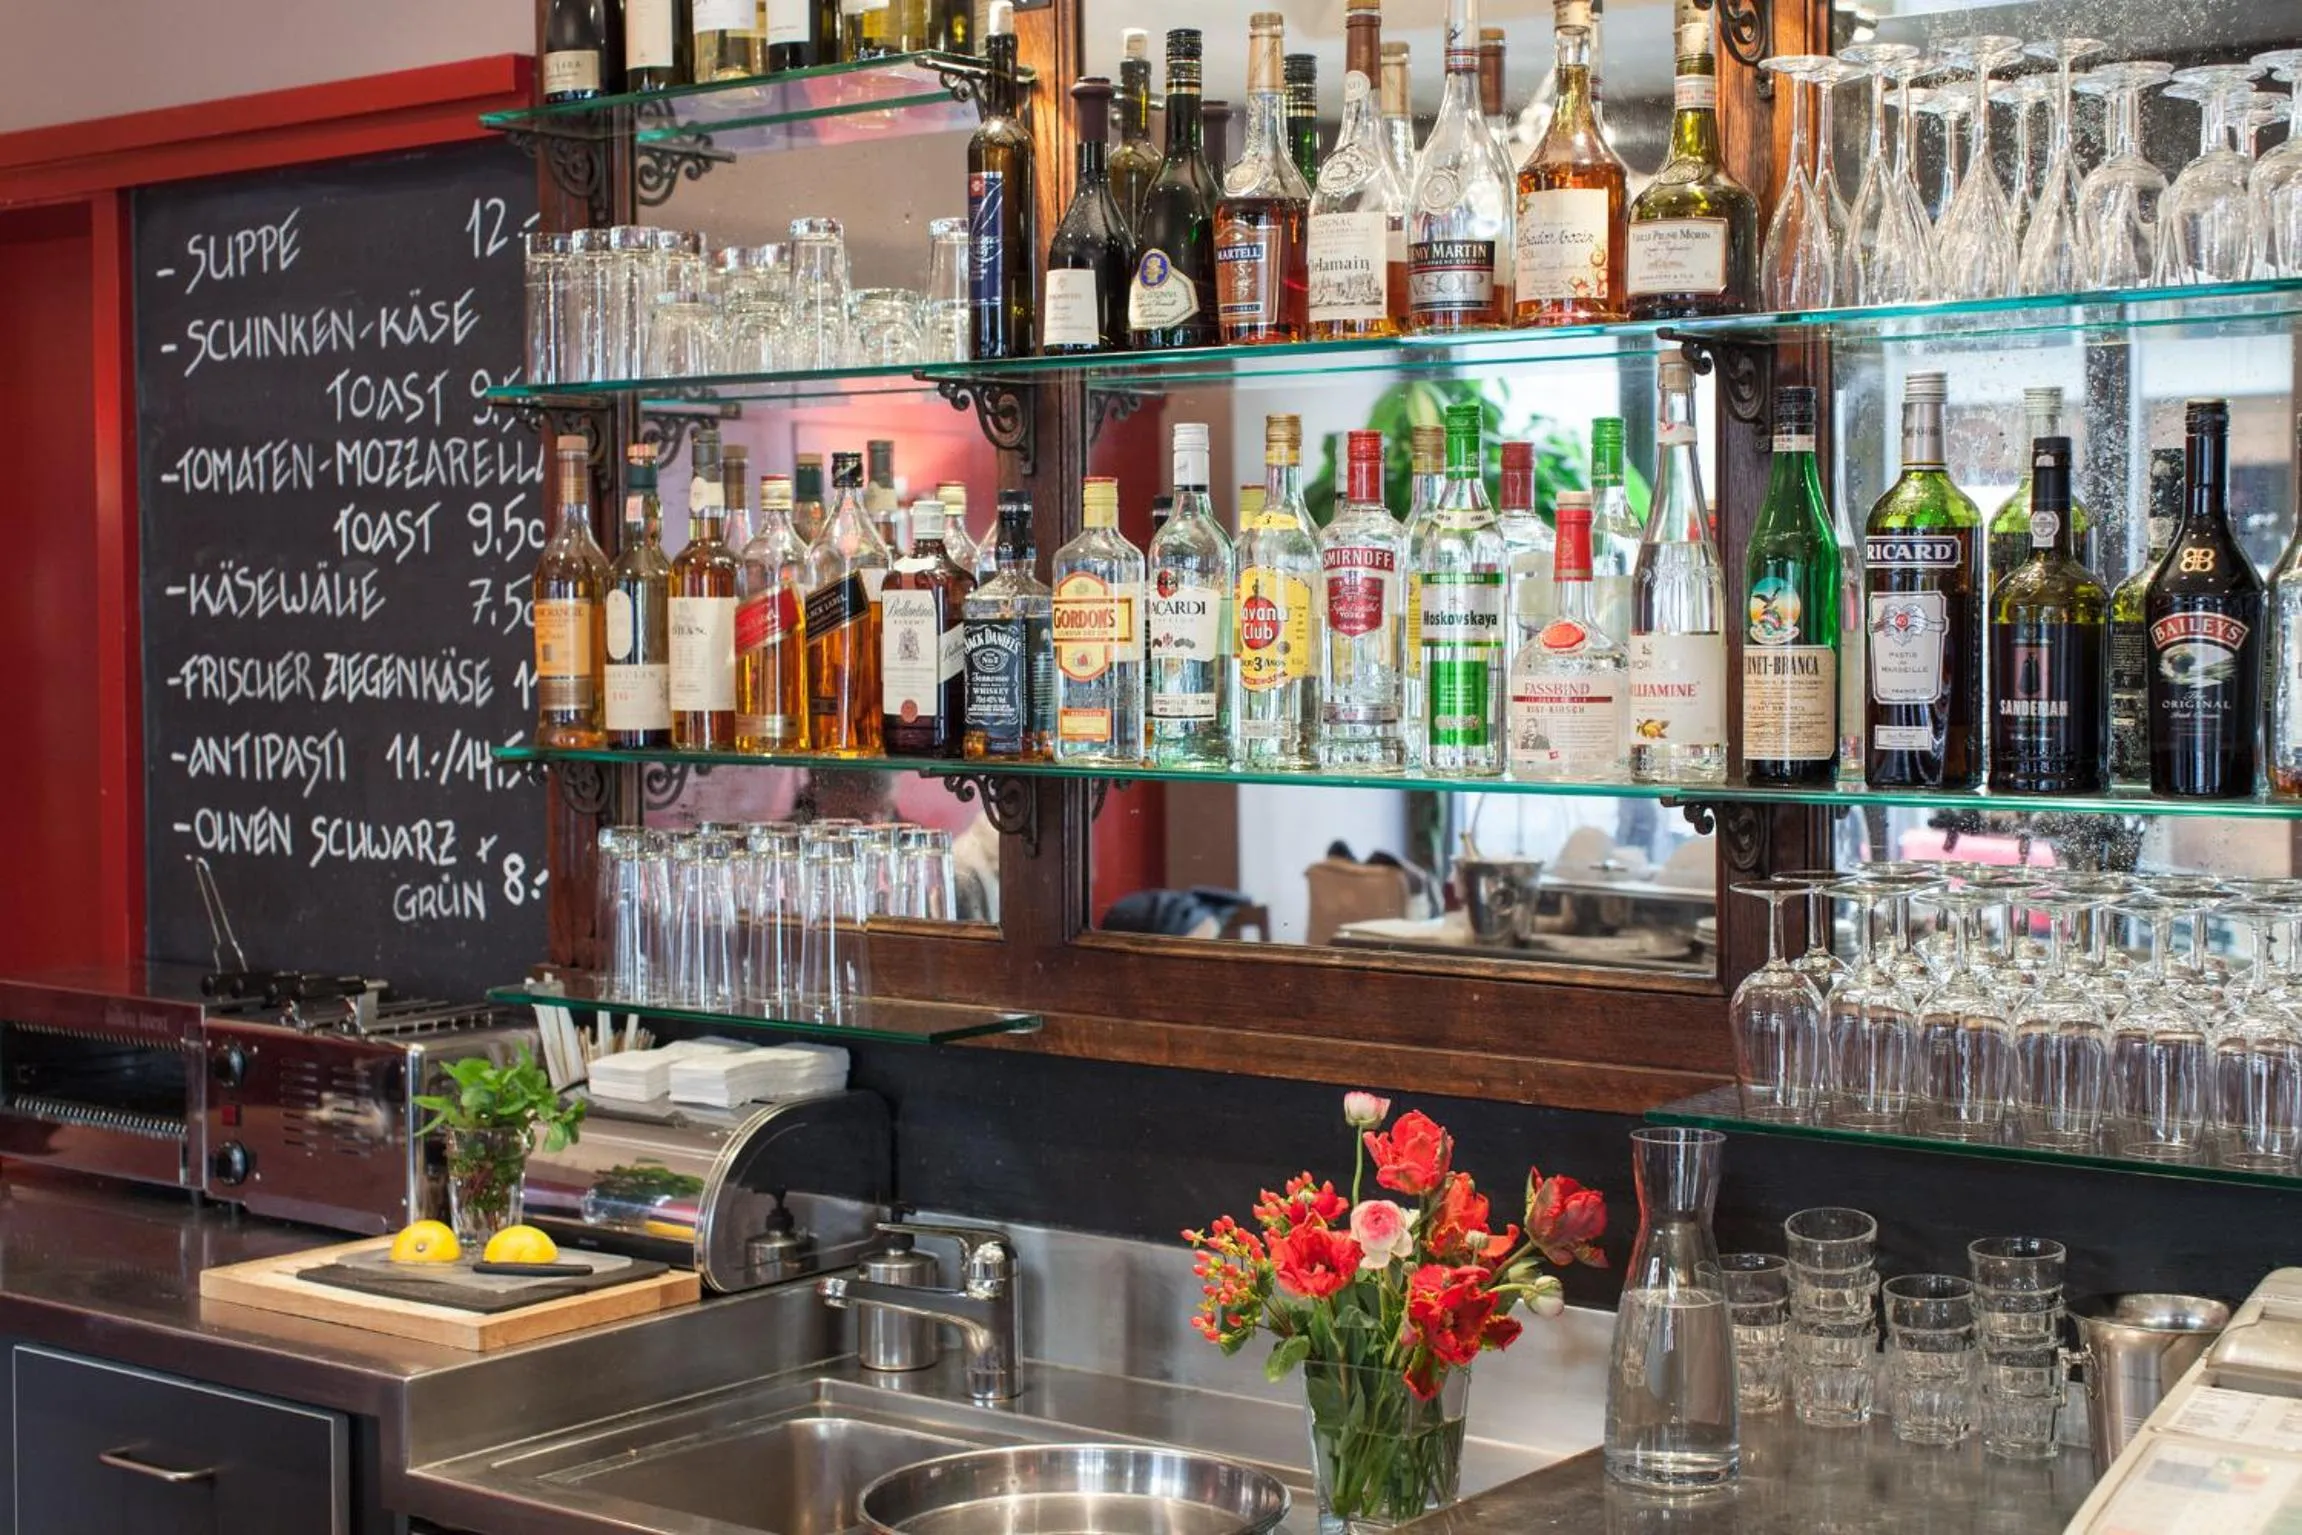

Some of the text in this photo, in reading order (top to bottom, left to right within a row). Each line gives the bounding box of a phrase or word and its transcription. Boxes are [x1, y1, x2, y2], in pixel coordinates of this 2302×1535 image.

[1680, 229, 1711, 239] MORIN
[1432, 243, 1487, 259] MARTIN
[326, 368, 449, 426] TOAST
[333, 491, 545, 565] TOAST 9.50
[1323, 549, 1391, 568] SMIRNOFF
[1867, 543, 1951, 562] RICARD
[1053, 607, 1116, 629] GORDON'S
[1243, 625, 1273, 640] Club
[2154, 615, 2243, 641] BAILEYS
[1254, 656, 1263, 671] 3
[321, 648, 494, 709] ZIEGENKÄSE
[972, 687, 1009, 695] WHISKEY
[1524, 682, 1591, 696] FASSBIND
[2161, 700, 2232, 710] ORIGINAL
[393, 872, 486, 922] GRÜN
